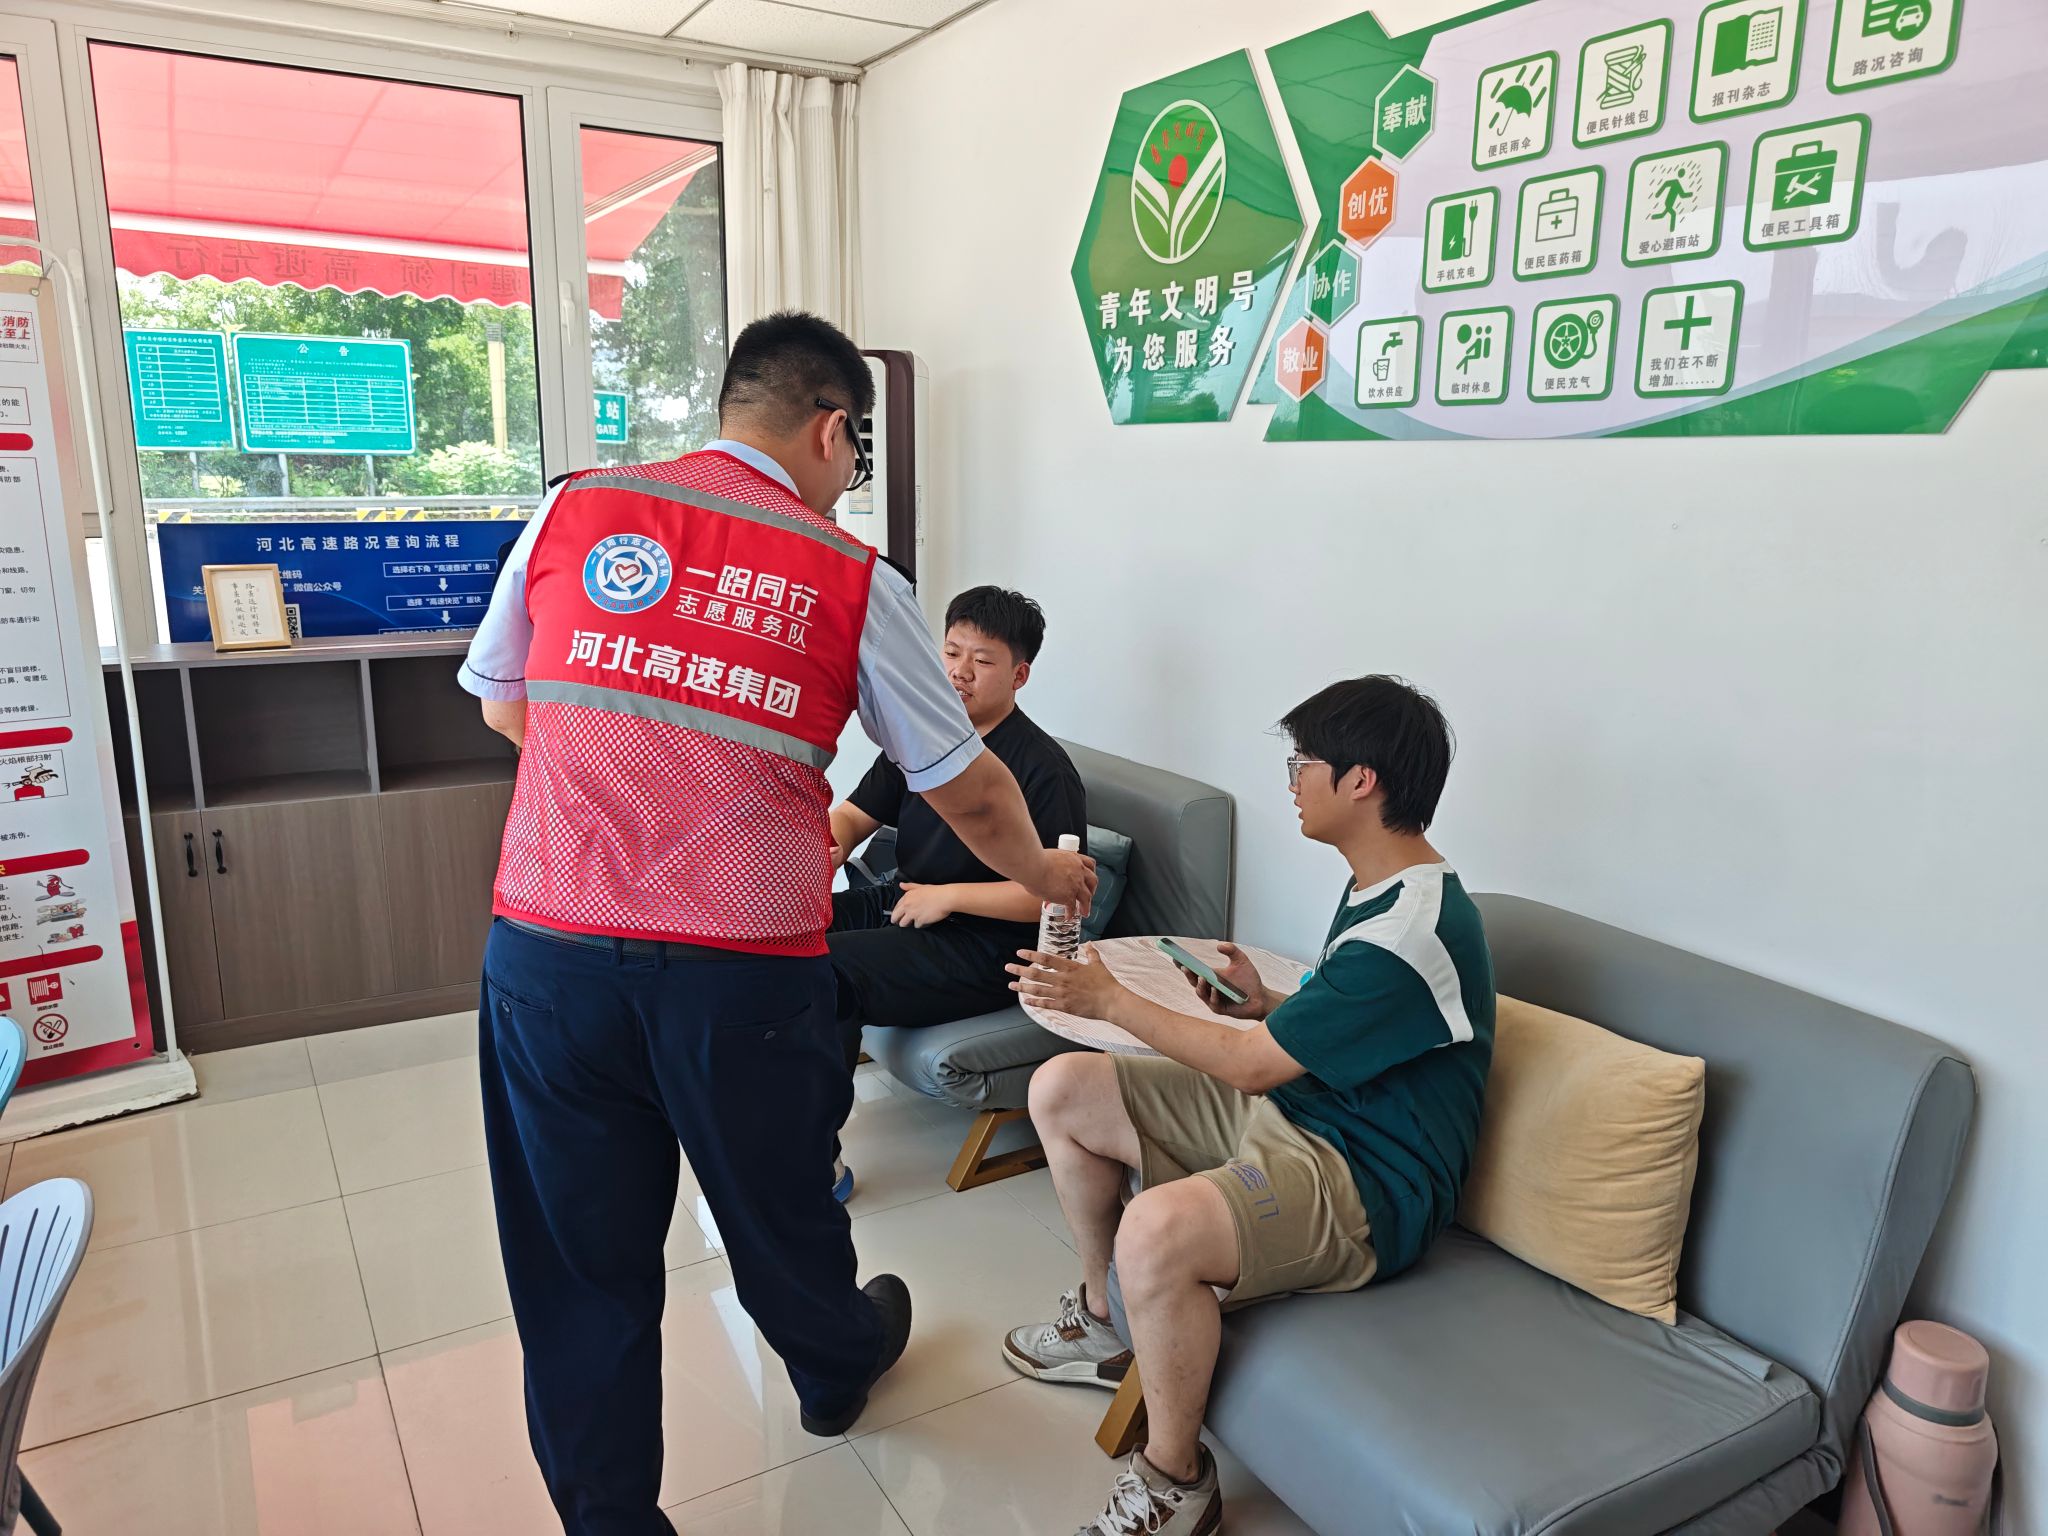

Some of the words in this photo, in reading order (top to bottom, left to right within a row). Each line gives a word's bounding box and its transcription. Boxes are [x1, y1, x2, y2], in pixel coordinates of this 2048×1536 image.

[1852, 47, 1924, 77] 路况咨询
[1711, 82, 1771, 107] 报刊杂志
[1382, 95, 1427, 133] 奉献
[1586, 109, 1649, 135] 便民针线包
[1487, 137, 1531, 158] 便民雨伞
[1348, 186, 1389, 220] 创优
[1761, 213, 1841, 238] 便民工具箱
[1638, 234, 1700, 255] 爱心避雨站
[1524, 250, 1582, 270] 便民医药箱
[1313, 270, 1352, 300] 协作
[1436, 266, 1476, 282] 手机充电
[1099, 270, 1255, 330] 青年文明号
[0, 328, 31, 340] 至上
[1112, 325, 1237, 375] 为您服务
[1283, 346, 1319, 374] 敬业
[1650, 354, 1719, 371] 我们在不断
[1368, 386, 1404, 399] 饮水供应
[1451, 381, 1491, 395] 临时休息
[1544, 376, 1591, 390] 便民充气
[0, 398, 21, 407] 的能
[597, 423, 619, 436] GATE
[256, 534, 460, 552] 河北高速路况查询流程
[0, 566, 29, 574] 和线路。
[685, 565, 819, 618] 一路同行
[676, 594, 807, 648] 志愿服务队
[566, 629, 801, 719] 河北高速集团
